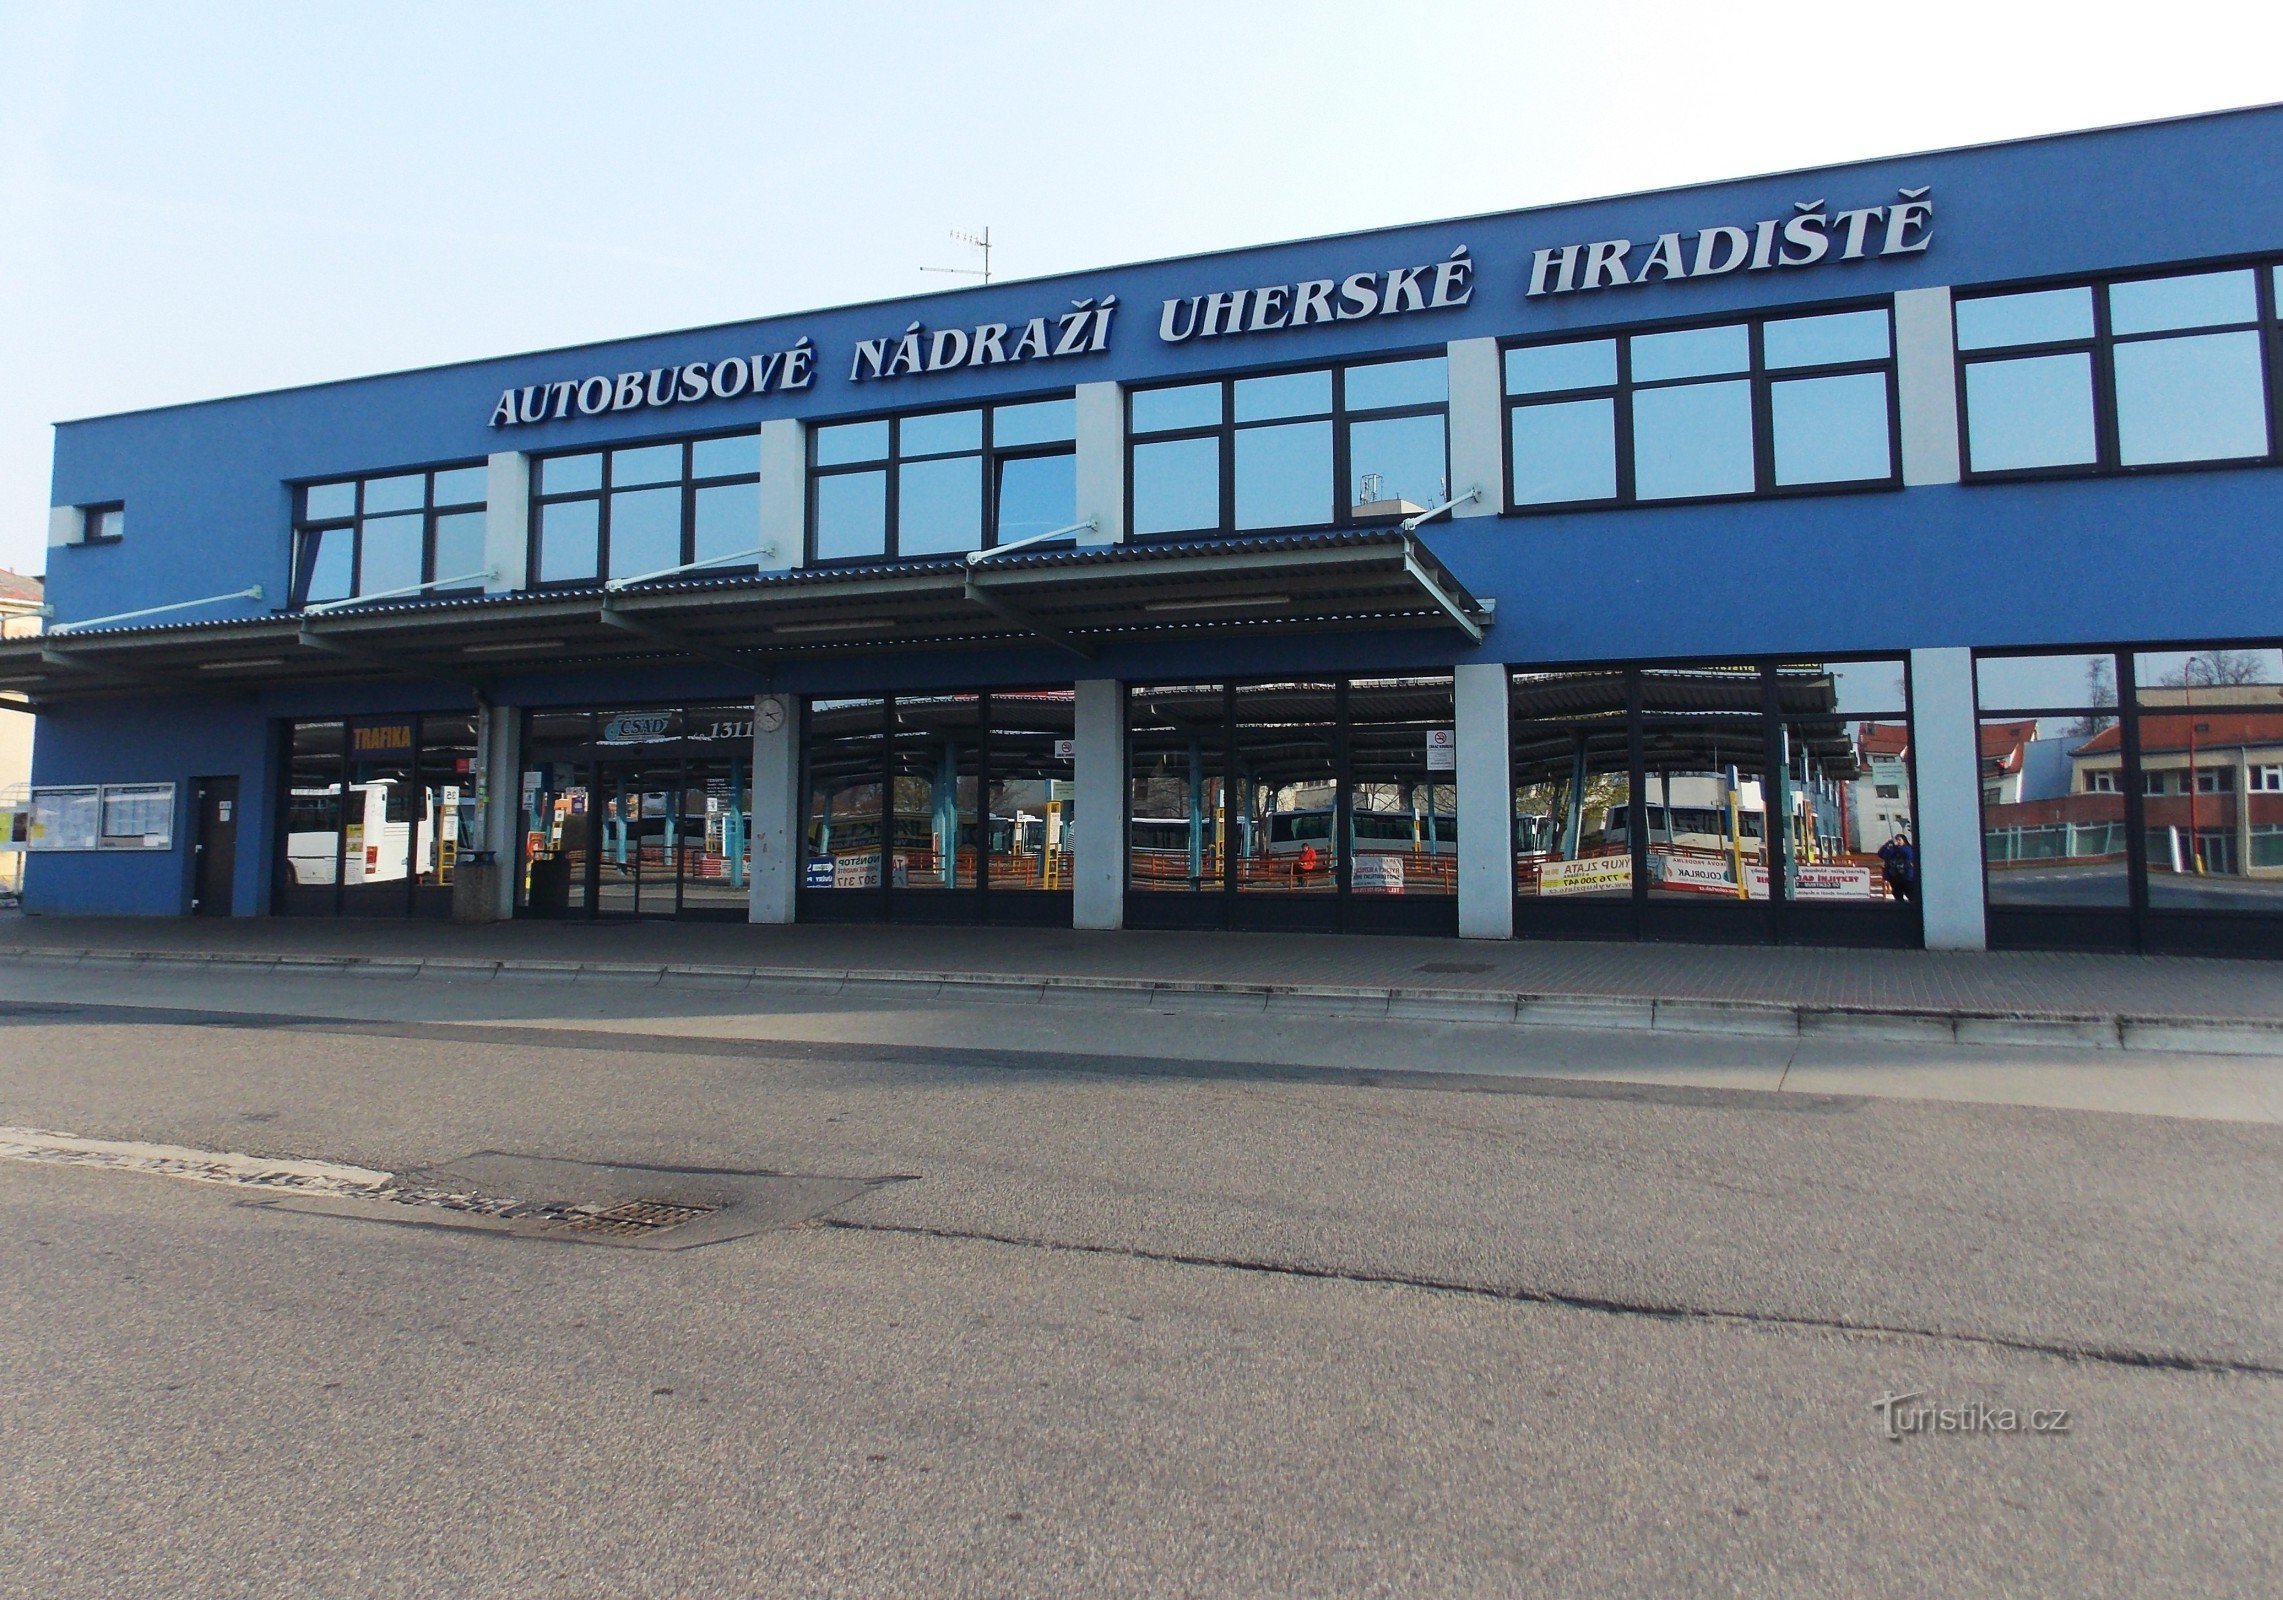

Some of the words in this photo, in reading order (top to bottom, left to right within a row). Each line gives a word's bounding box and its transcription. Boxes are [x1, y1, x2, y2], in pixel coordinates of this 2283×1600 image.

[487, 335, 816, 429] AUTOBUSOVÉ
[849, 294, 1120, 383] NÁDRAŽÍ
[1157, 244, 1475, 345] UHERSKÉ
[1525, 185, 1934, 298] HRADIŠTĚ
[352, 726, 410, 750] TRAFIKA
